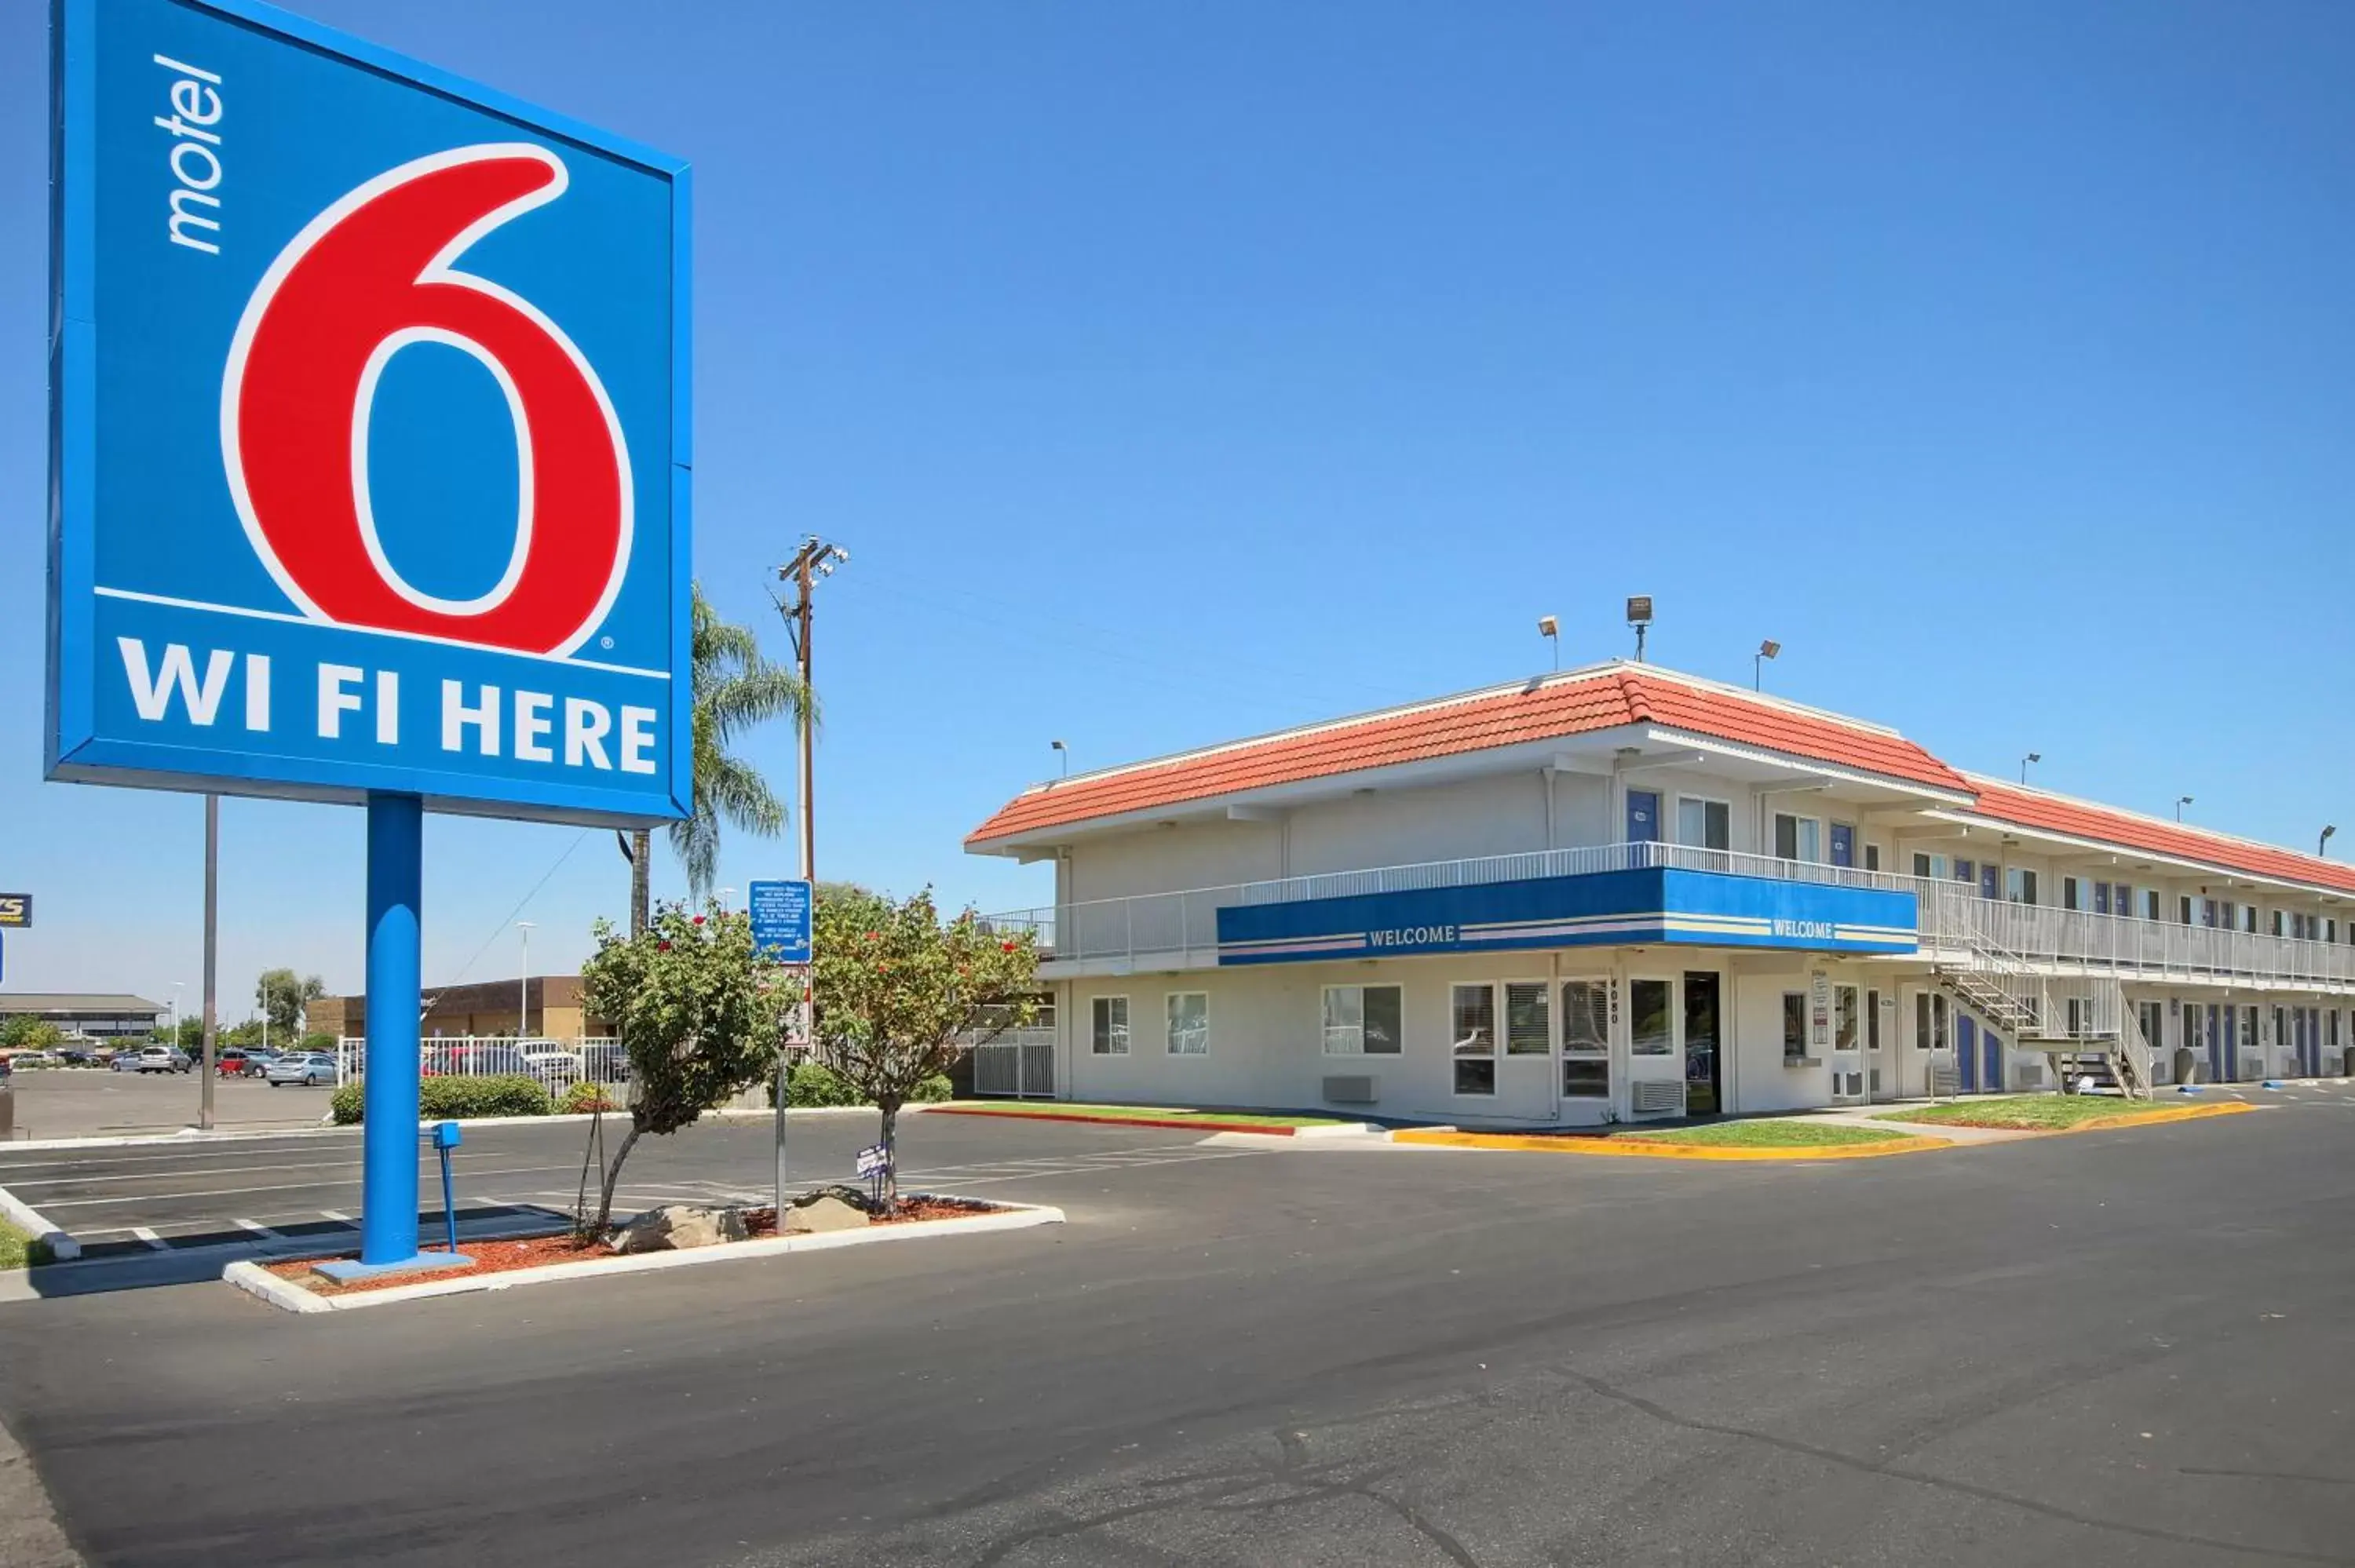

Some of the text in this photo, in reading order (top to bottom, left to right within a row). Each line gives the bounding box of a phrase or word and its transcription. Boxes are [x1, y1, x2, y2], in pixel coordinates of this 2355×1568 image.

[153, 54, 223, 254] motel
[220, 141, 635, 661] 6
[117, 636, 657, 775] WI FI HERE
[1369, 926, 1455, 947] WELCOME
[1773, 918, 1833, 939] WELCOME
